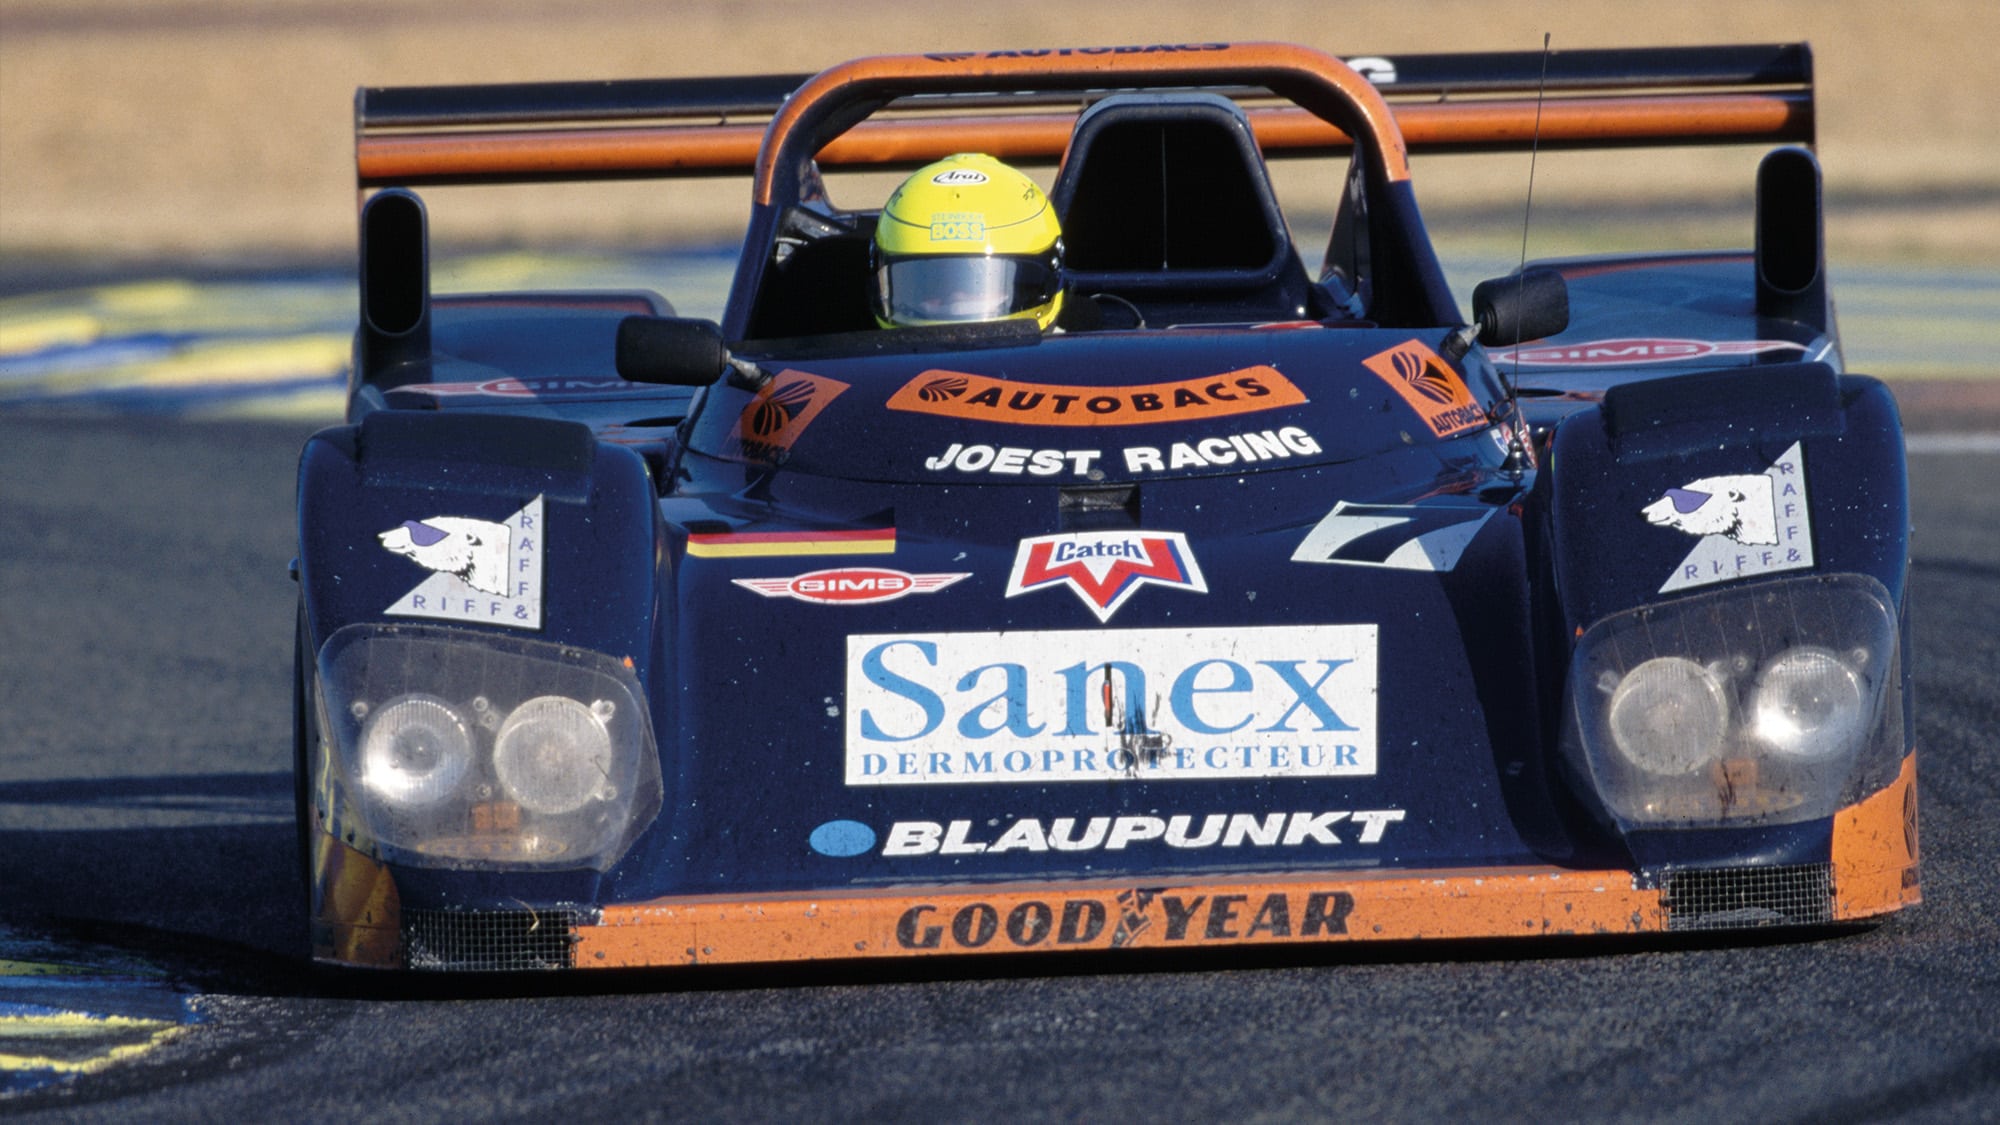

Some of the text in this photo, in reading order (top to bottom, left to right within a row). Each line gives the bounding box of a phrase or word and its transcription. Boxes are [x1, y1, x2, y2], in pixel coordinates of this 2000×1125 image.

[940, 171, 981, 181] Arai
[931, 222, 984, 240] BOSS
[1519, 345, 1699, 360] SIMS
[965, 377, 1272, 415] AUTOBACS
[925, 427, 1322, 476] JOEST RACING
[1326, 505, 1488, 563] 7
[1055, 539, 1144, 562] Catch
[799, 577, 905, 593] SIMS
[860, 640, 1360, 742] Sanex
[862, 744, 1360, 776] DERMOPROTECTEUR
[881, 809, 1404, 857] BLAUPUNKT
